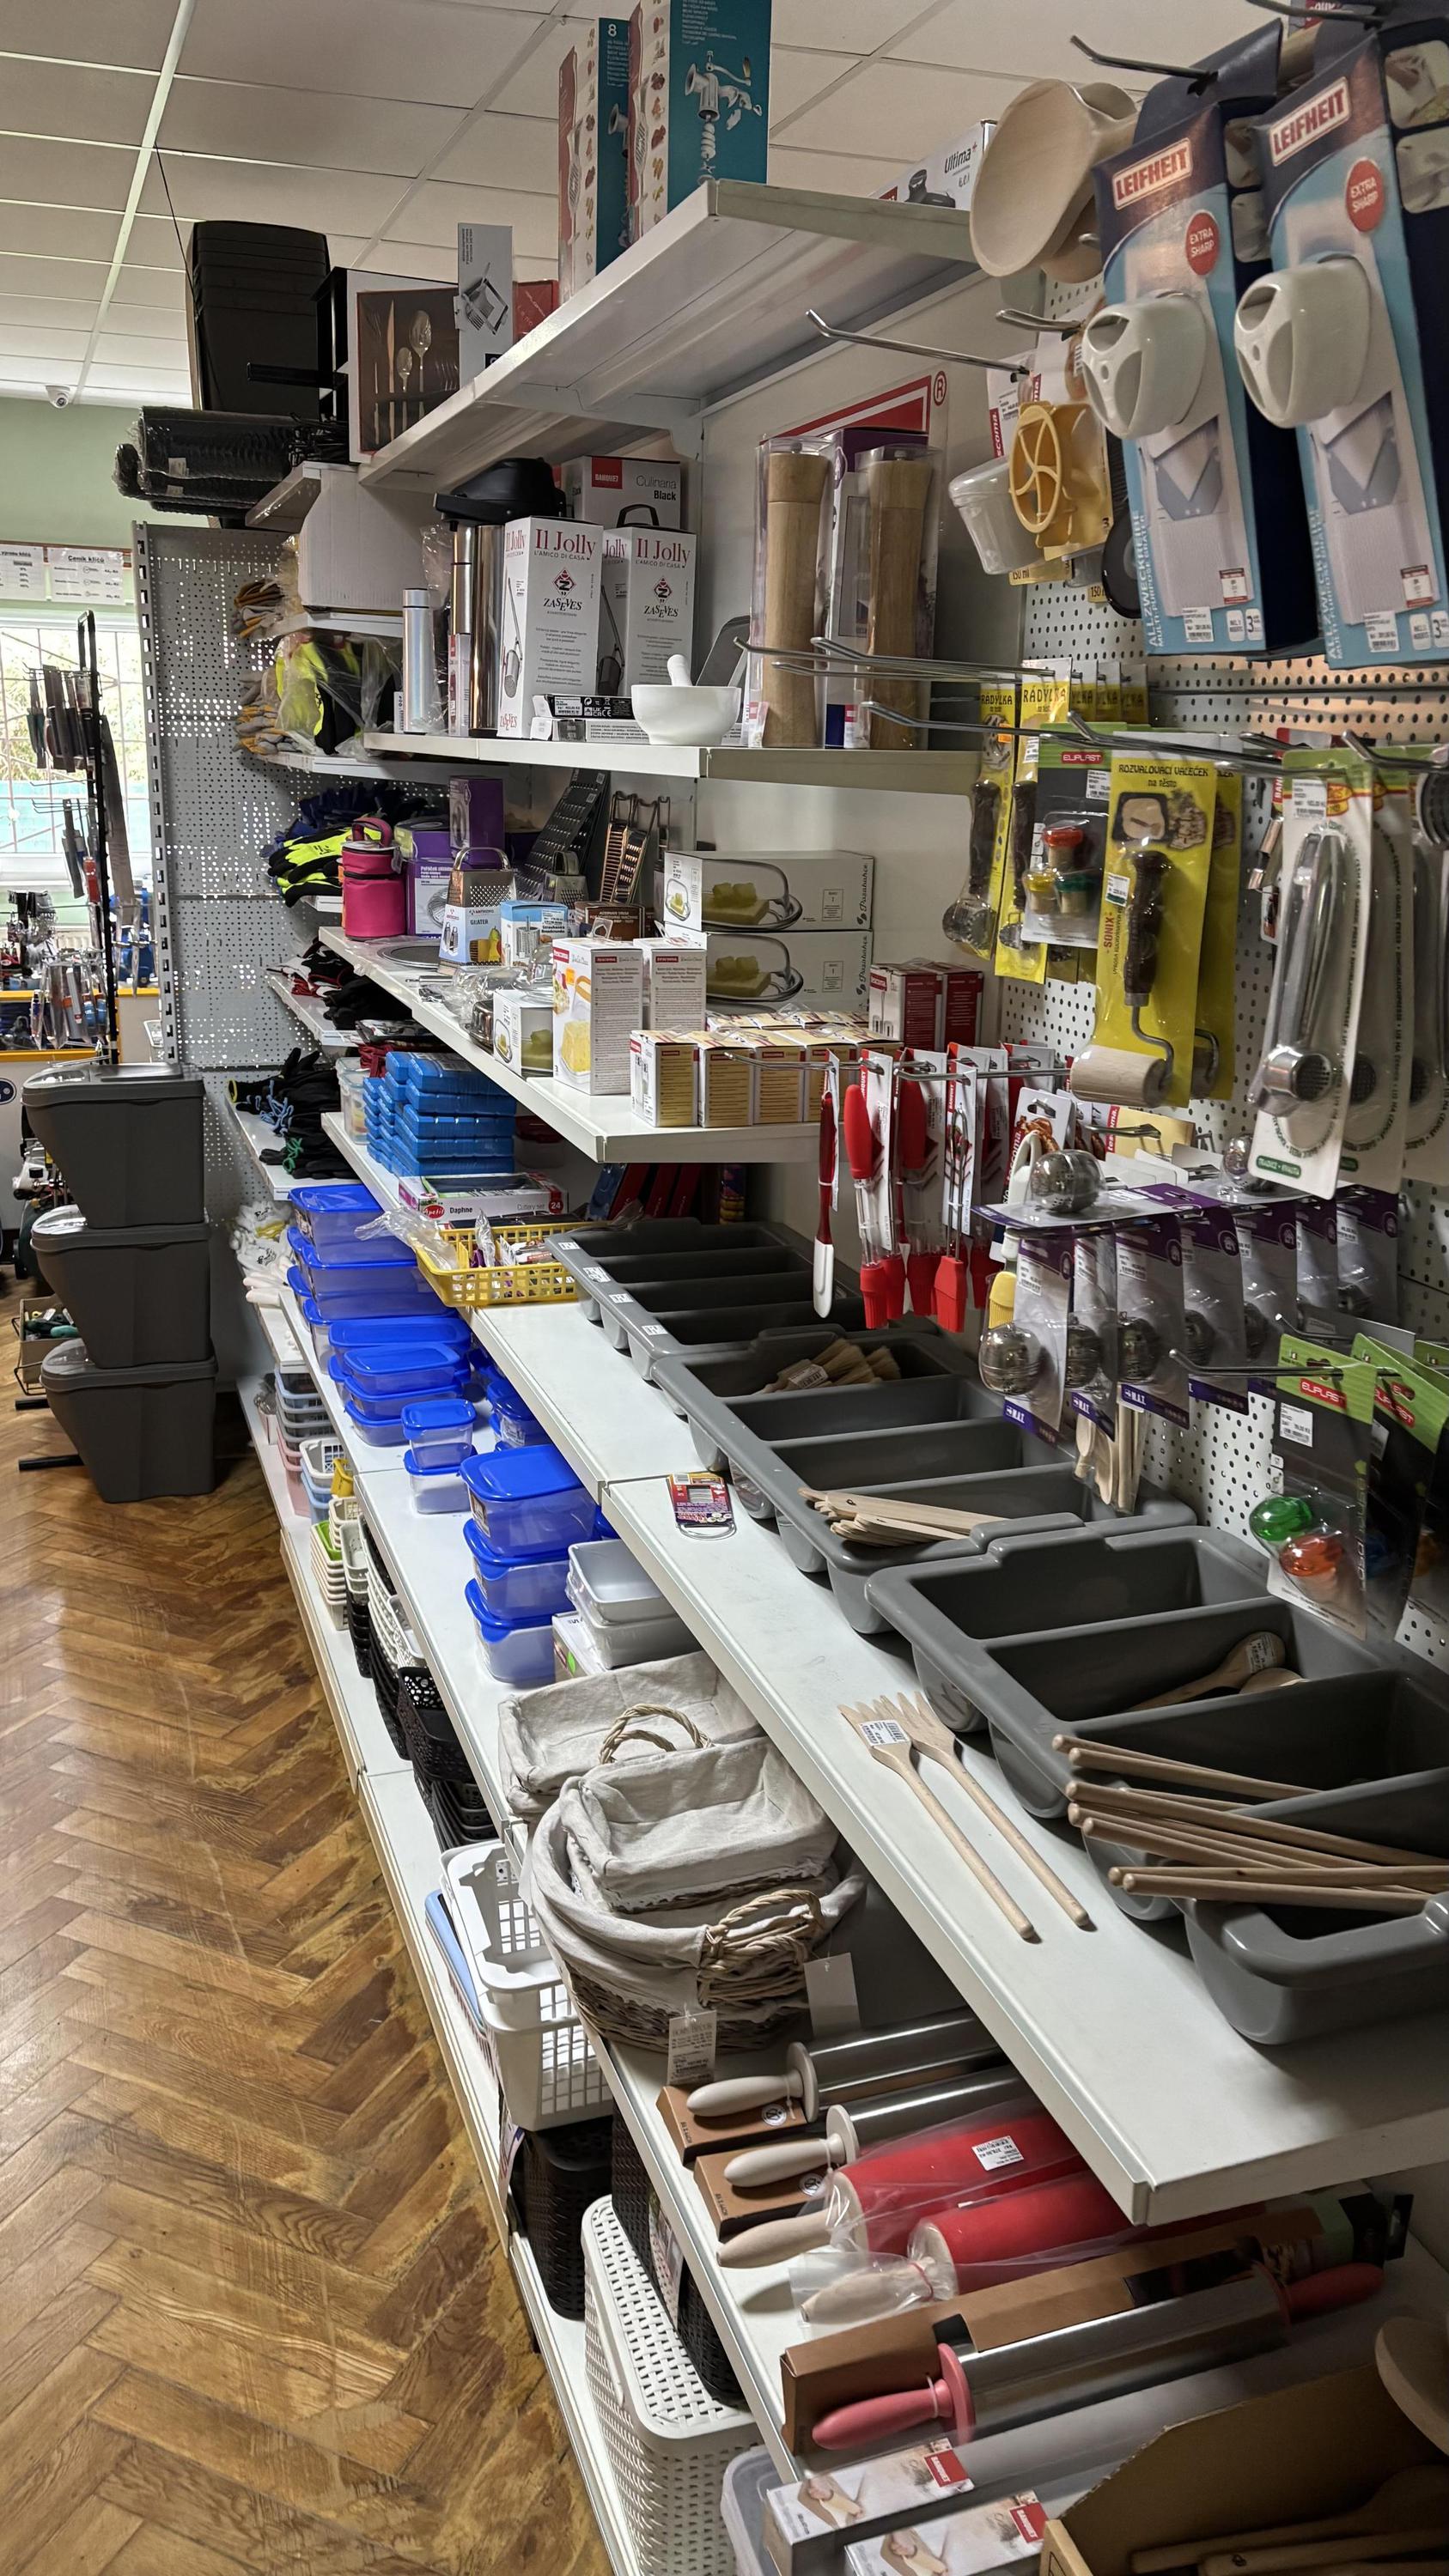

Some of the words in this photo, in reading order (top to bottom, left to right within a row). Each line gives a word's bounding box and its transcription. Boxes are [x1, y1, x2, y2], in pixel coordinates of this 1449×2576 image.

[607, 23, 618, 38] 8
[1273, 87, 1345, 155] LEIFHEIT
[1116, 147, 1190, 200] LEIFHEIT
[1349, 176, 1378, 199] EXTRA
[1352, 191, 1379, 214] SHARP
[1189, 228, 1214, 245] EXTRA
[1190, 240, 1215, 258] SHARP
[636, 475, 677, 489] Culinaria
[654, 489, 677, 501] Black
[536, 528, 548, 550] Il
[553, 532, 596, 559] Jolly
[604, 538, 628, 559] Jolly
[636, 538, 648, 559] Il
[653, 540, 691, 567] Jolly
[543, 598, 582, 612] ZASEVES
[643, 605, 679, 619] ZASEVES
[1246, 615, 1255, 633] 3
[1431, 619, 1442, 639] 3
[1103, 916, 1115, 948] SONIX
[550, 1201, 561, 1210] 24
[930, 2456, 952, 2483] BANQUET
[1017, 2509, 1038, 2537] BANQUET
